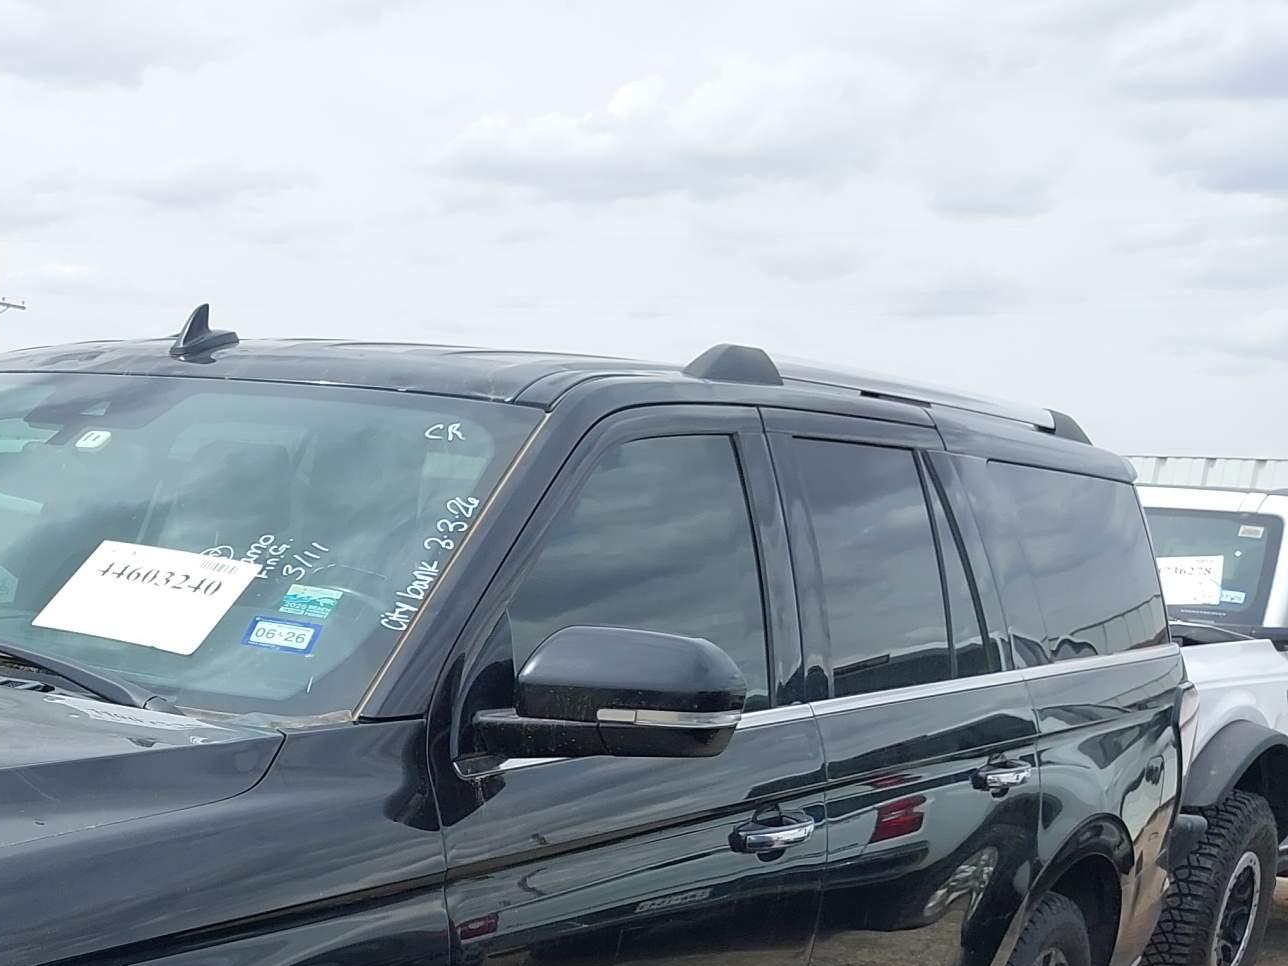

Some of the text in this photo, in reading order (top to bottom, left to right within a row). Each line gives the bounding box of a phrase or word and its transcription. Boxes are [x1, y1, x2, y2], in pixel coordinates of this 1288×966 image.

[424, 423, 467, 441] CR
[282, 542, 329, 581] 3/11
[97, 561, 223, 596] 44603240
[380, 599, 418, 631] City
